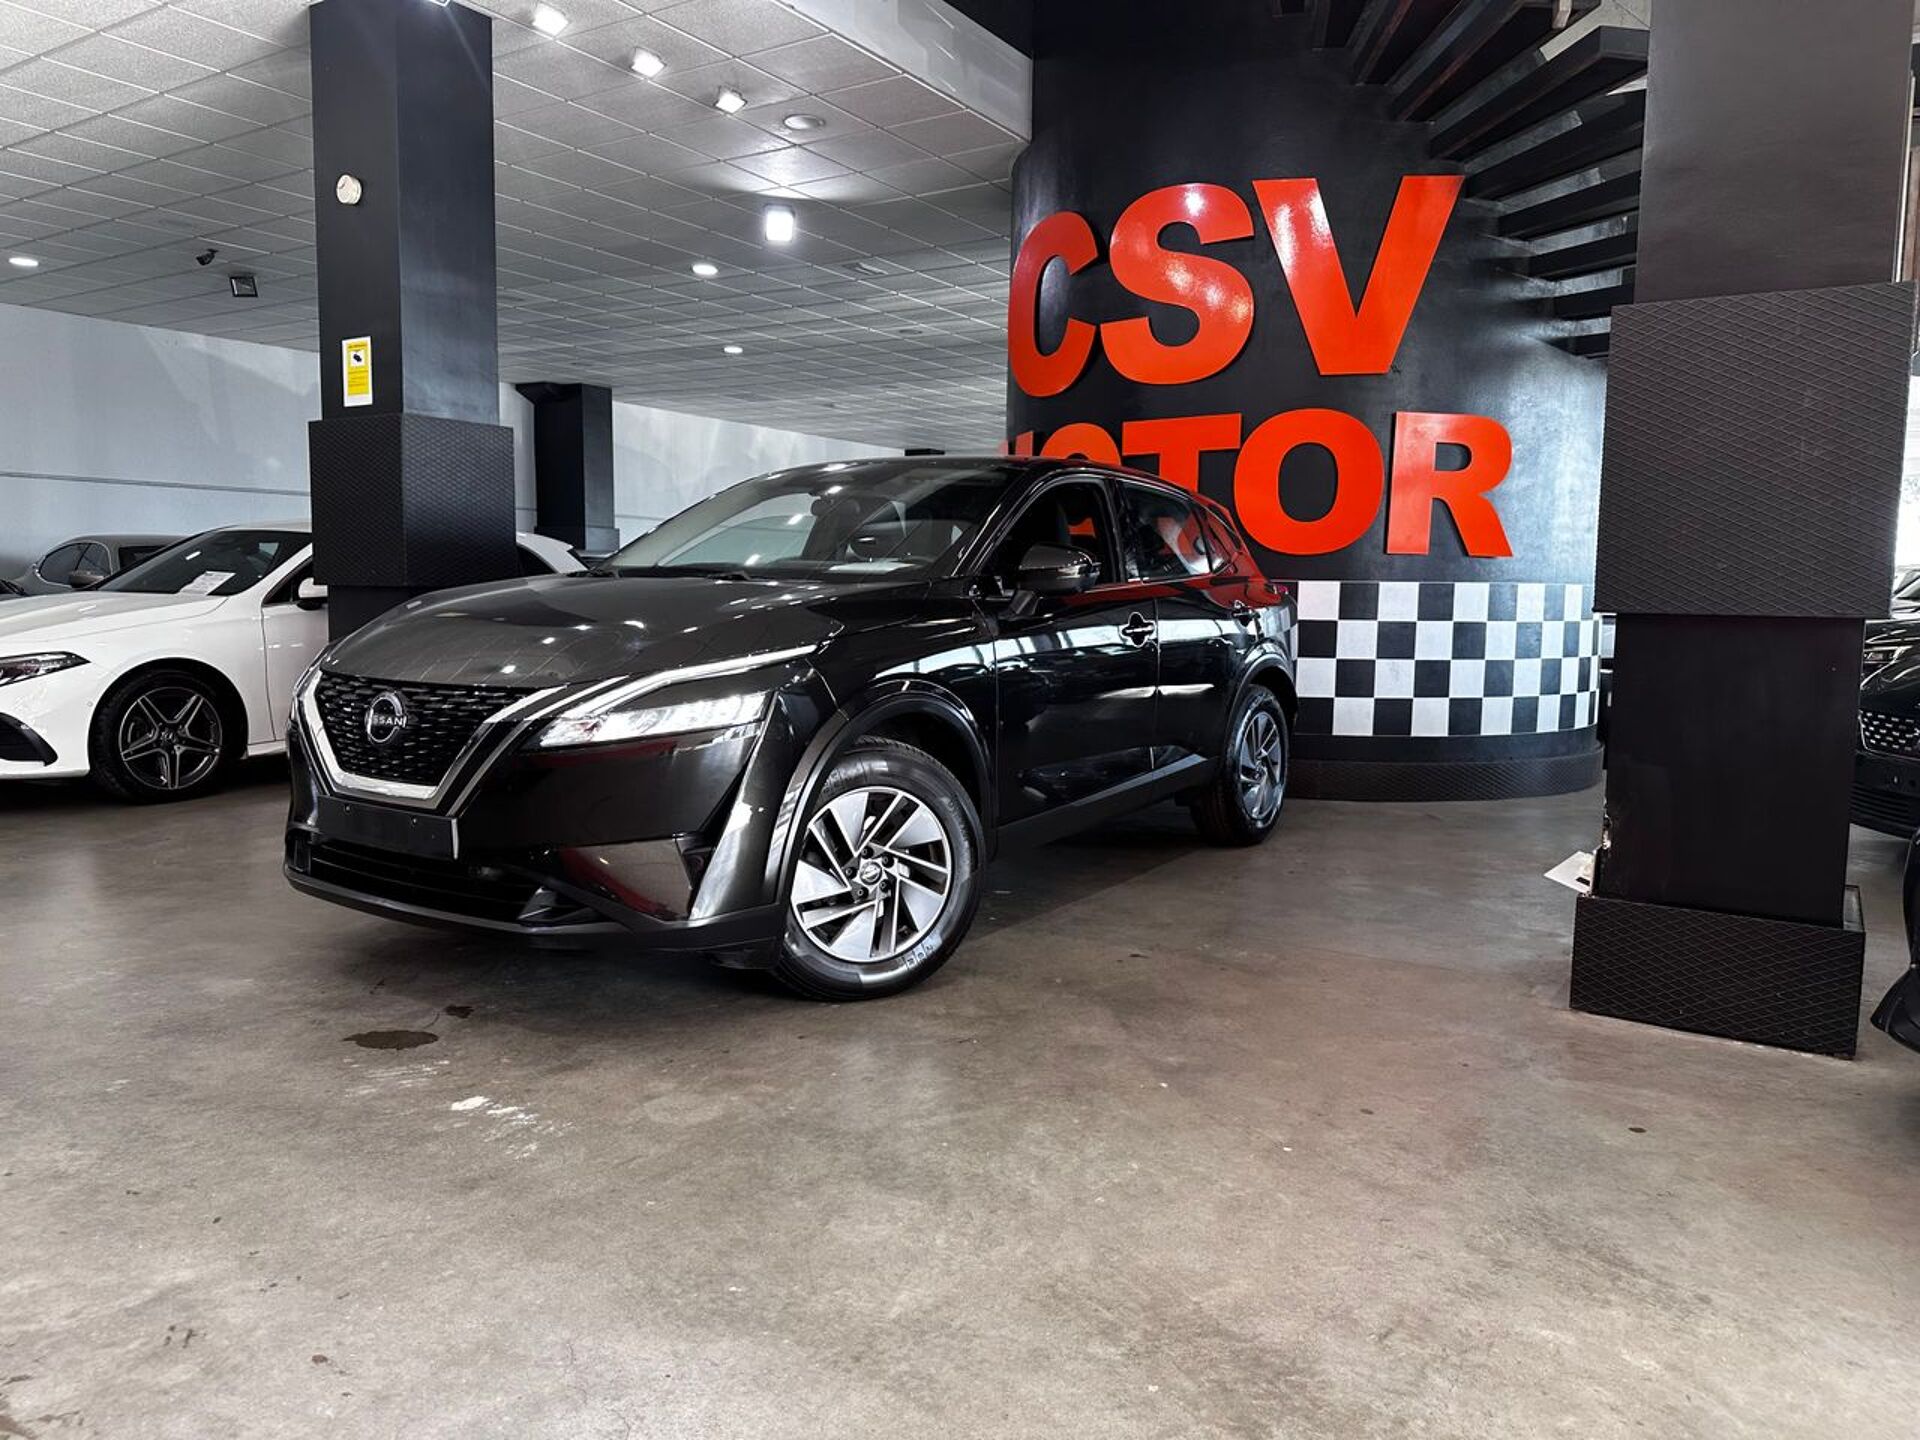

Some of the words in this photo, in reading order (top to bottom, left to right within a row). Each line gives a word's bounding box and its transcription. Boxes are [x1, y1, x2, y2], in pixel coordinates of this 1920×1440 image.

[1008, 174, 1465, 397] CSV
[998, 408, 1513, 557] TOR
[367, 714, 404, 726] SSAN
